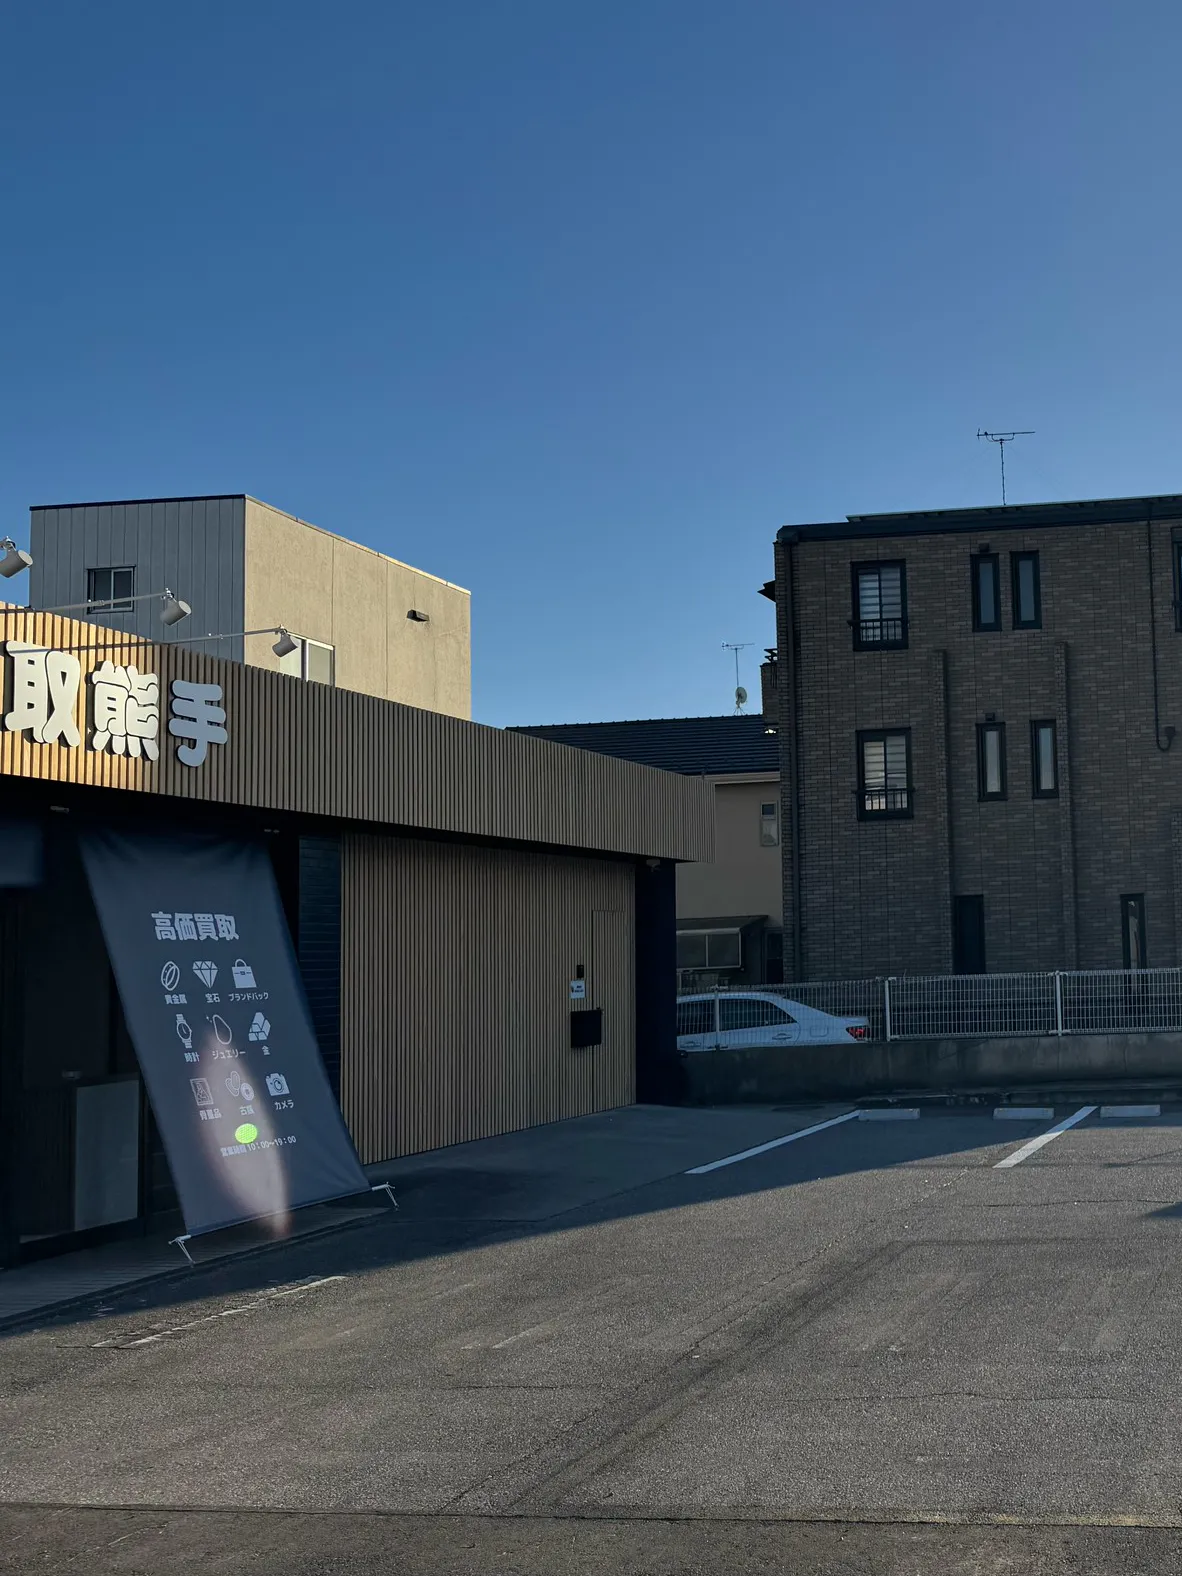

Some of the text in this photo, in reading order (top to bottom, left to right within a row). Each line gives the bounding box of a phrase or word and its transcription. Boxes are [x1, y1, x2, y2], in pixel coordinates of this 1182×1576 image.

[5, 640, 229, 768] 取熊手
[151, 911, 239, 941] 高価買取
[205, 993, 221, 1003] 宝石
[184, 1051, 200, 1063] 時計
[212, 1048, 247, 1060] ジュエリー
[274, 1099, 295, 1111] カメラ
